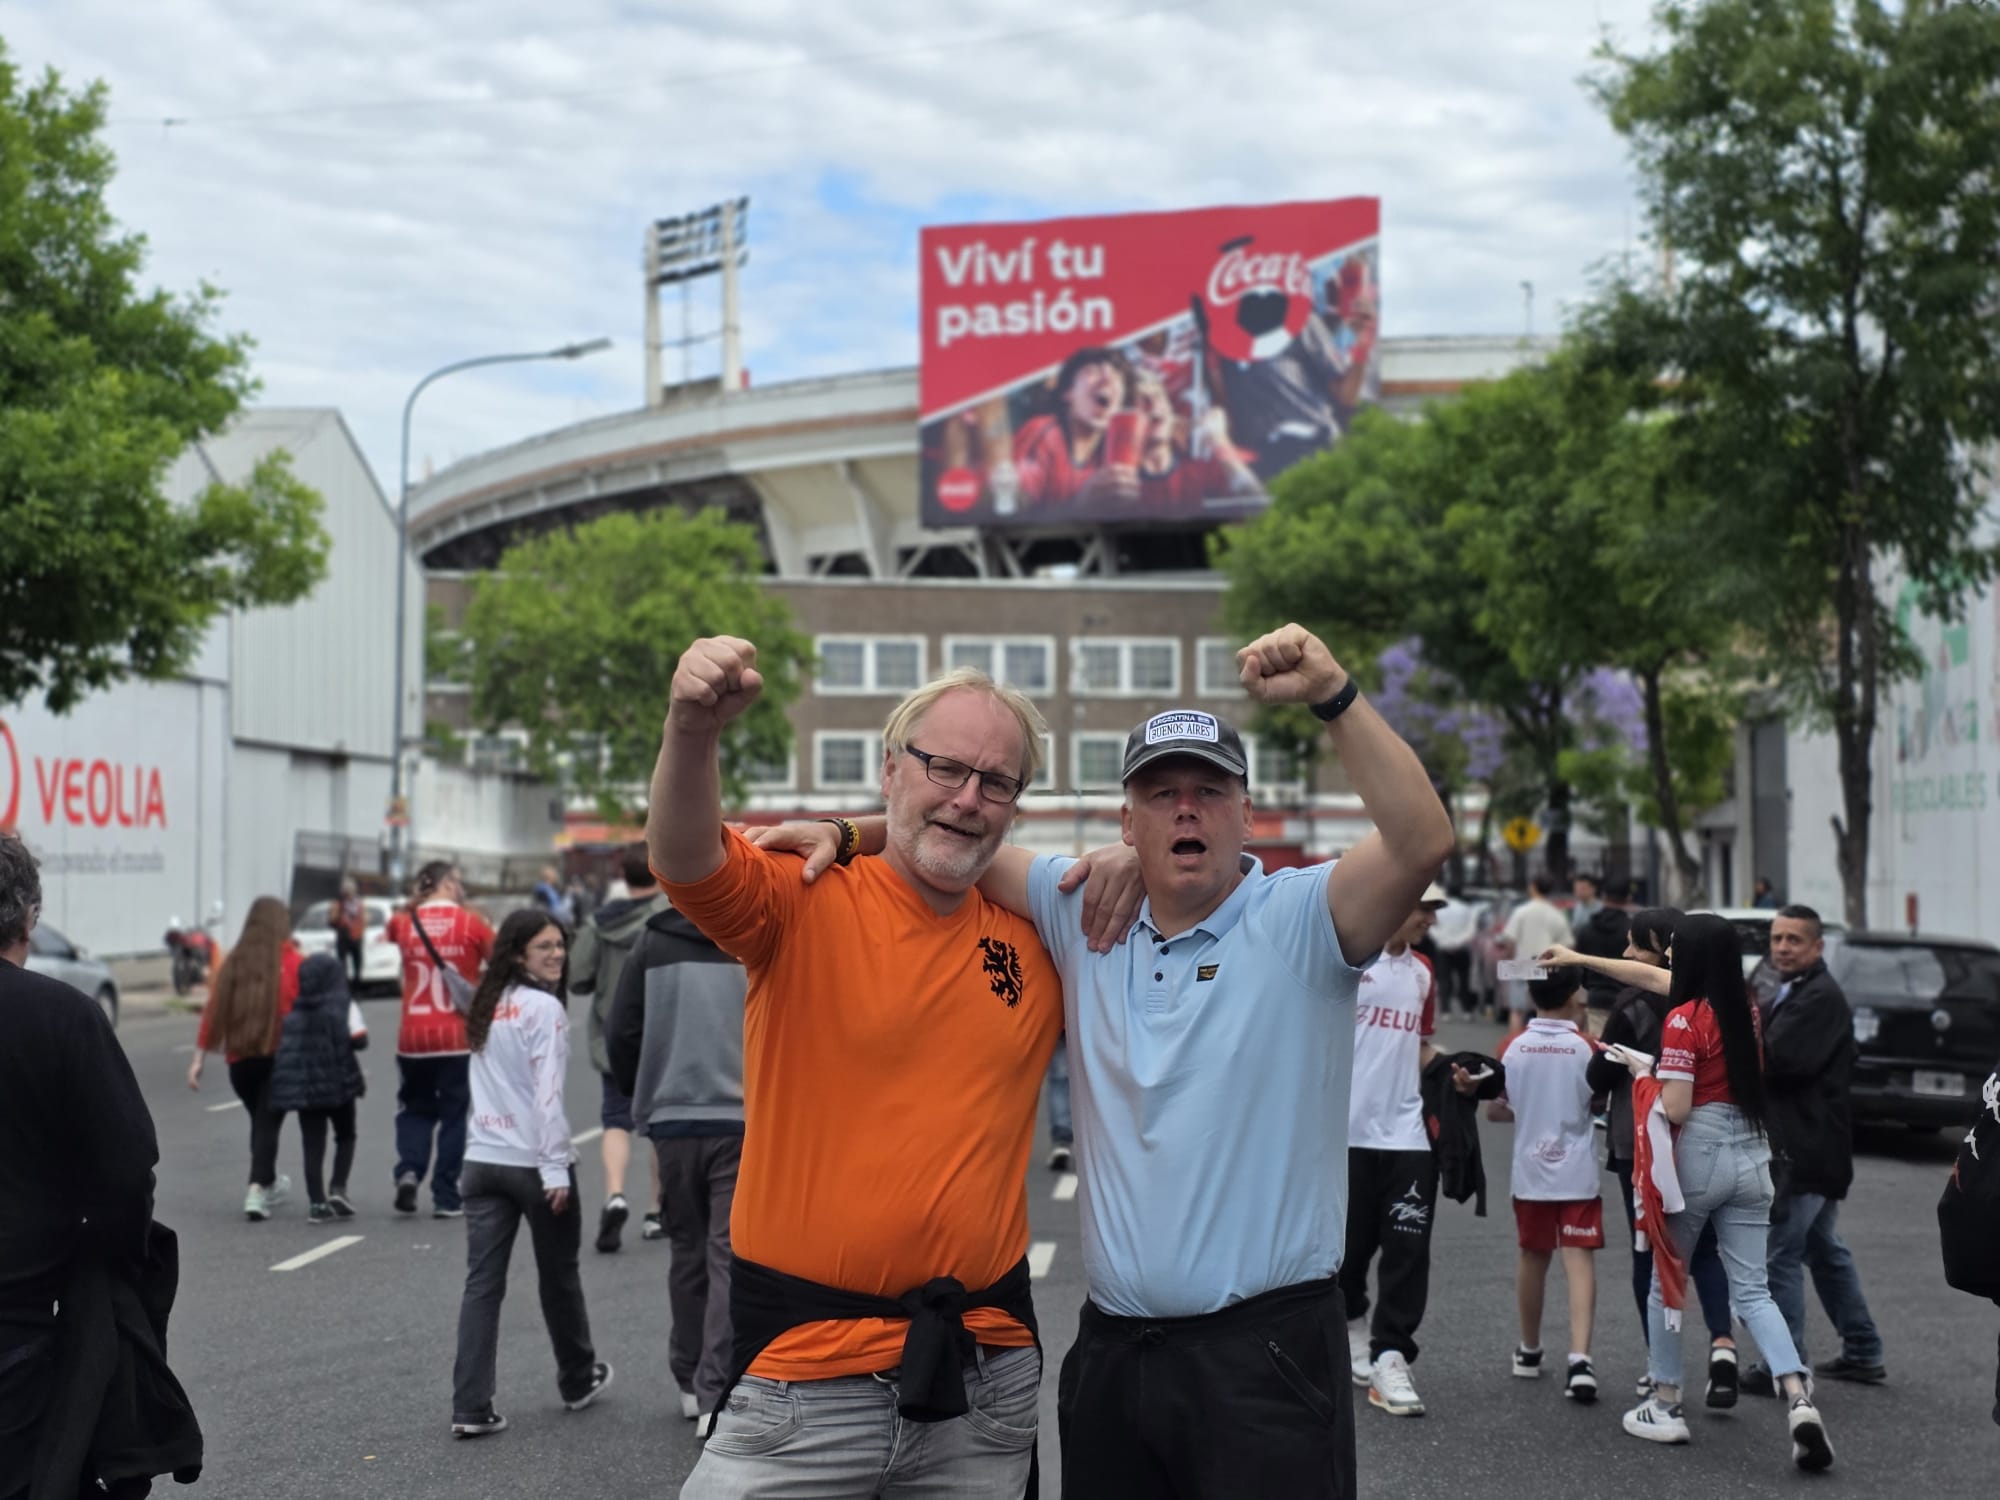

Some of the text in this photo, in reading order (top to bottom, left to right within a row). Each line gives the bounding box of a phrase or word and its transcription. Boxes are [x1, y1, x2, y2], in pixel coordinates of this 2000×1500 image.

[936, 236, 1106, 287] Viví tu
[936, 287, 1114, 348] pasión
[1151, 723, 1211, 740] BUENOS AIRES
[34, 756, 168, 830] VEOLIA
[1519, 1044, 1576, 1055] Casablanca
